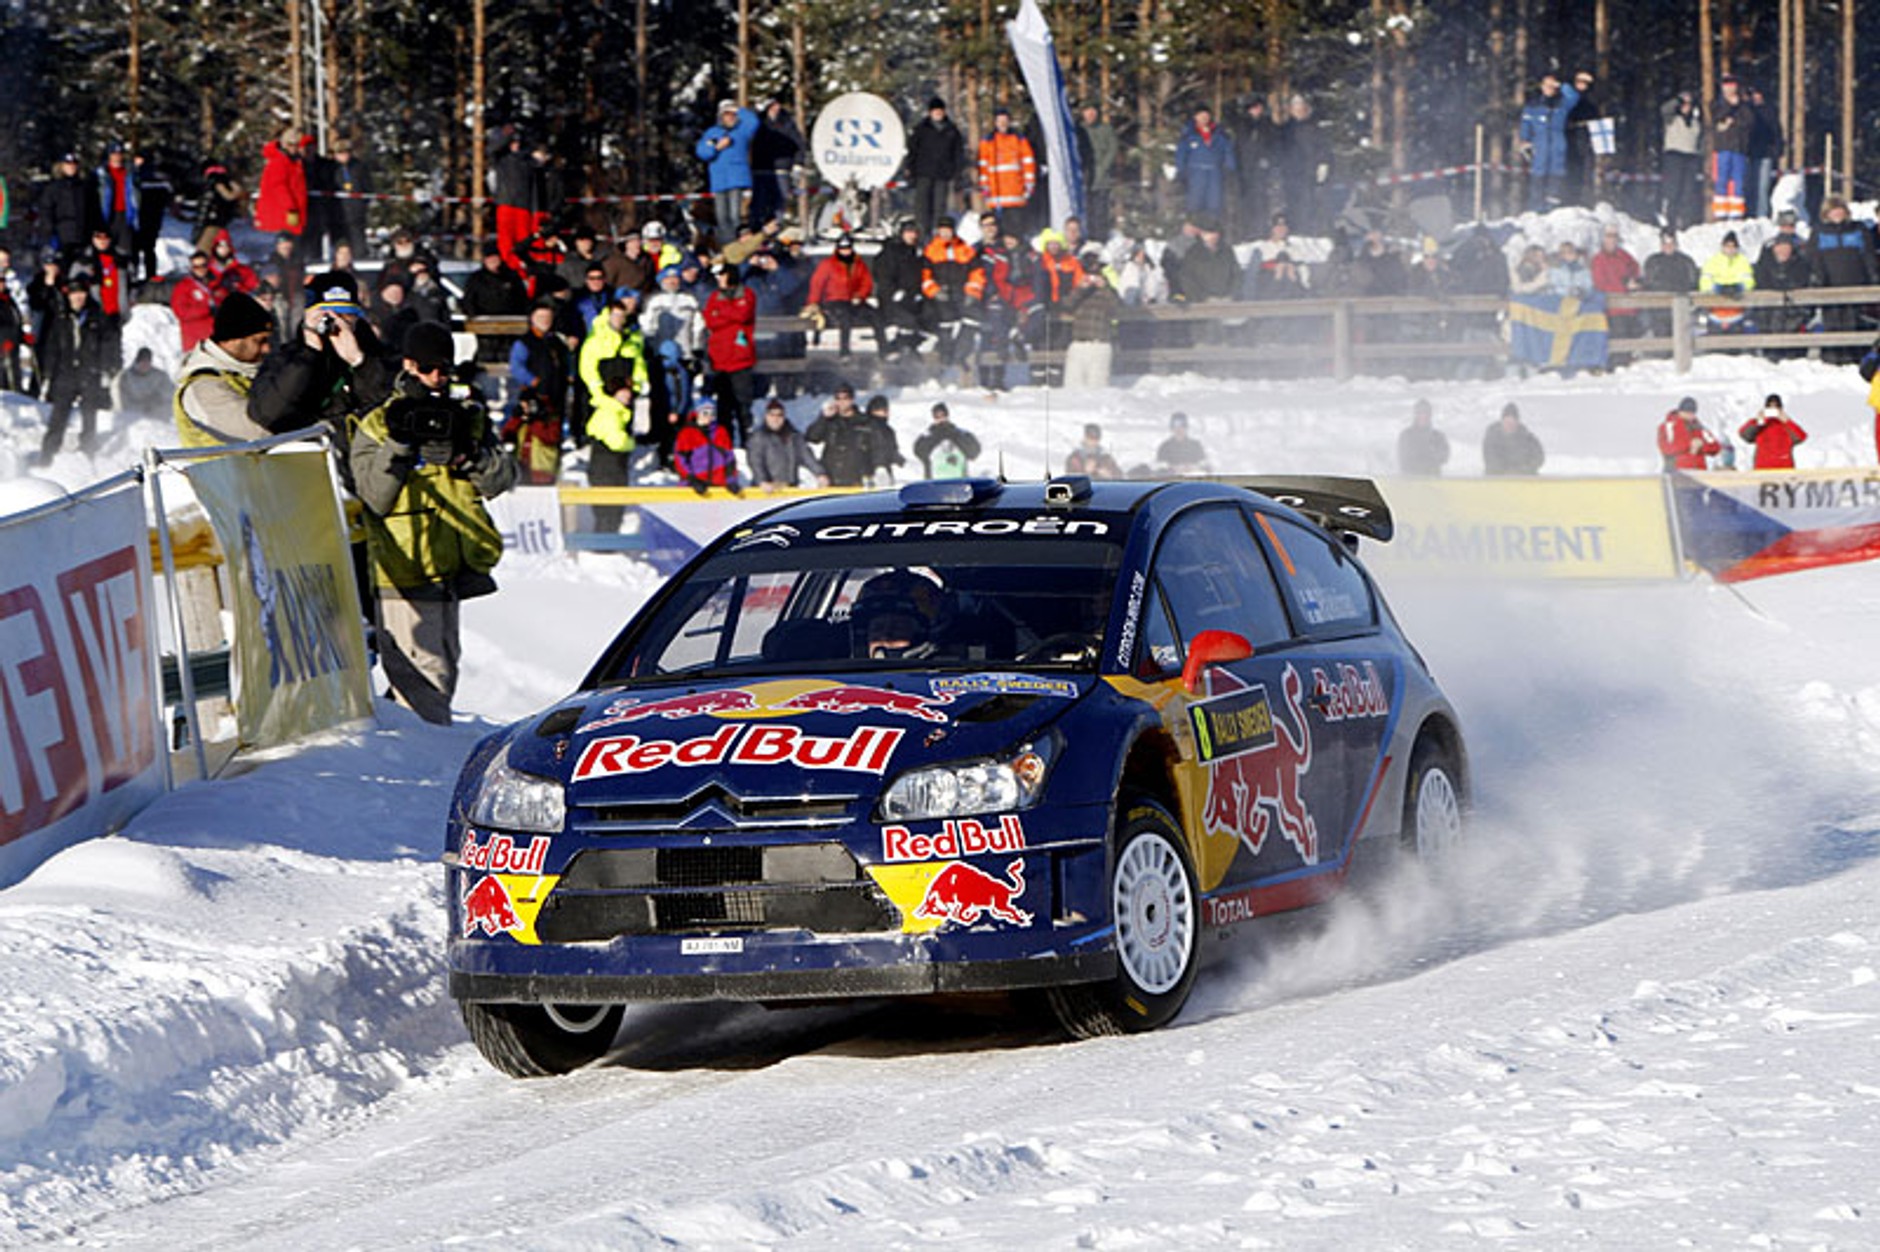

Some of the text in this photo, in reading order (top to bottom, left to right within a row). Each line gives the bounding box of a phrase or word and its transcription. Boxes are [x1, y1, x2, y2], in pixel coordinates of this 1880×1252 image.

[834, 119, 882, 147] SR
[938, 680, 1069, 691] RALLY SWEDEN
[573, 724, 904, 780] Red Bull
[1193, 706, 1212, 760] 8
[490, 834, 551, 873] Bull
[883, 815, 1025, 861] Red Bull
[1208, 896, 1254, 925] TOTAL
